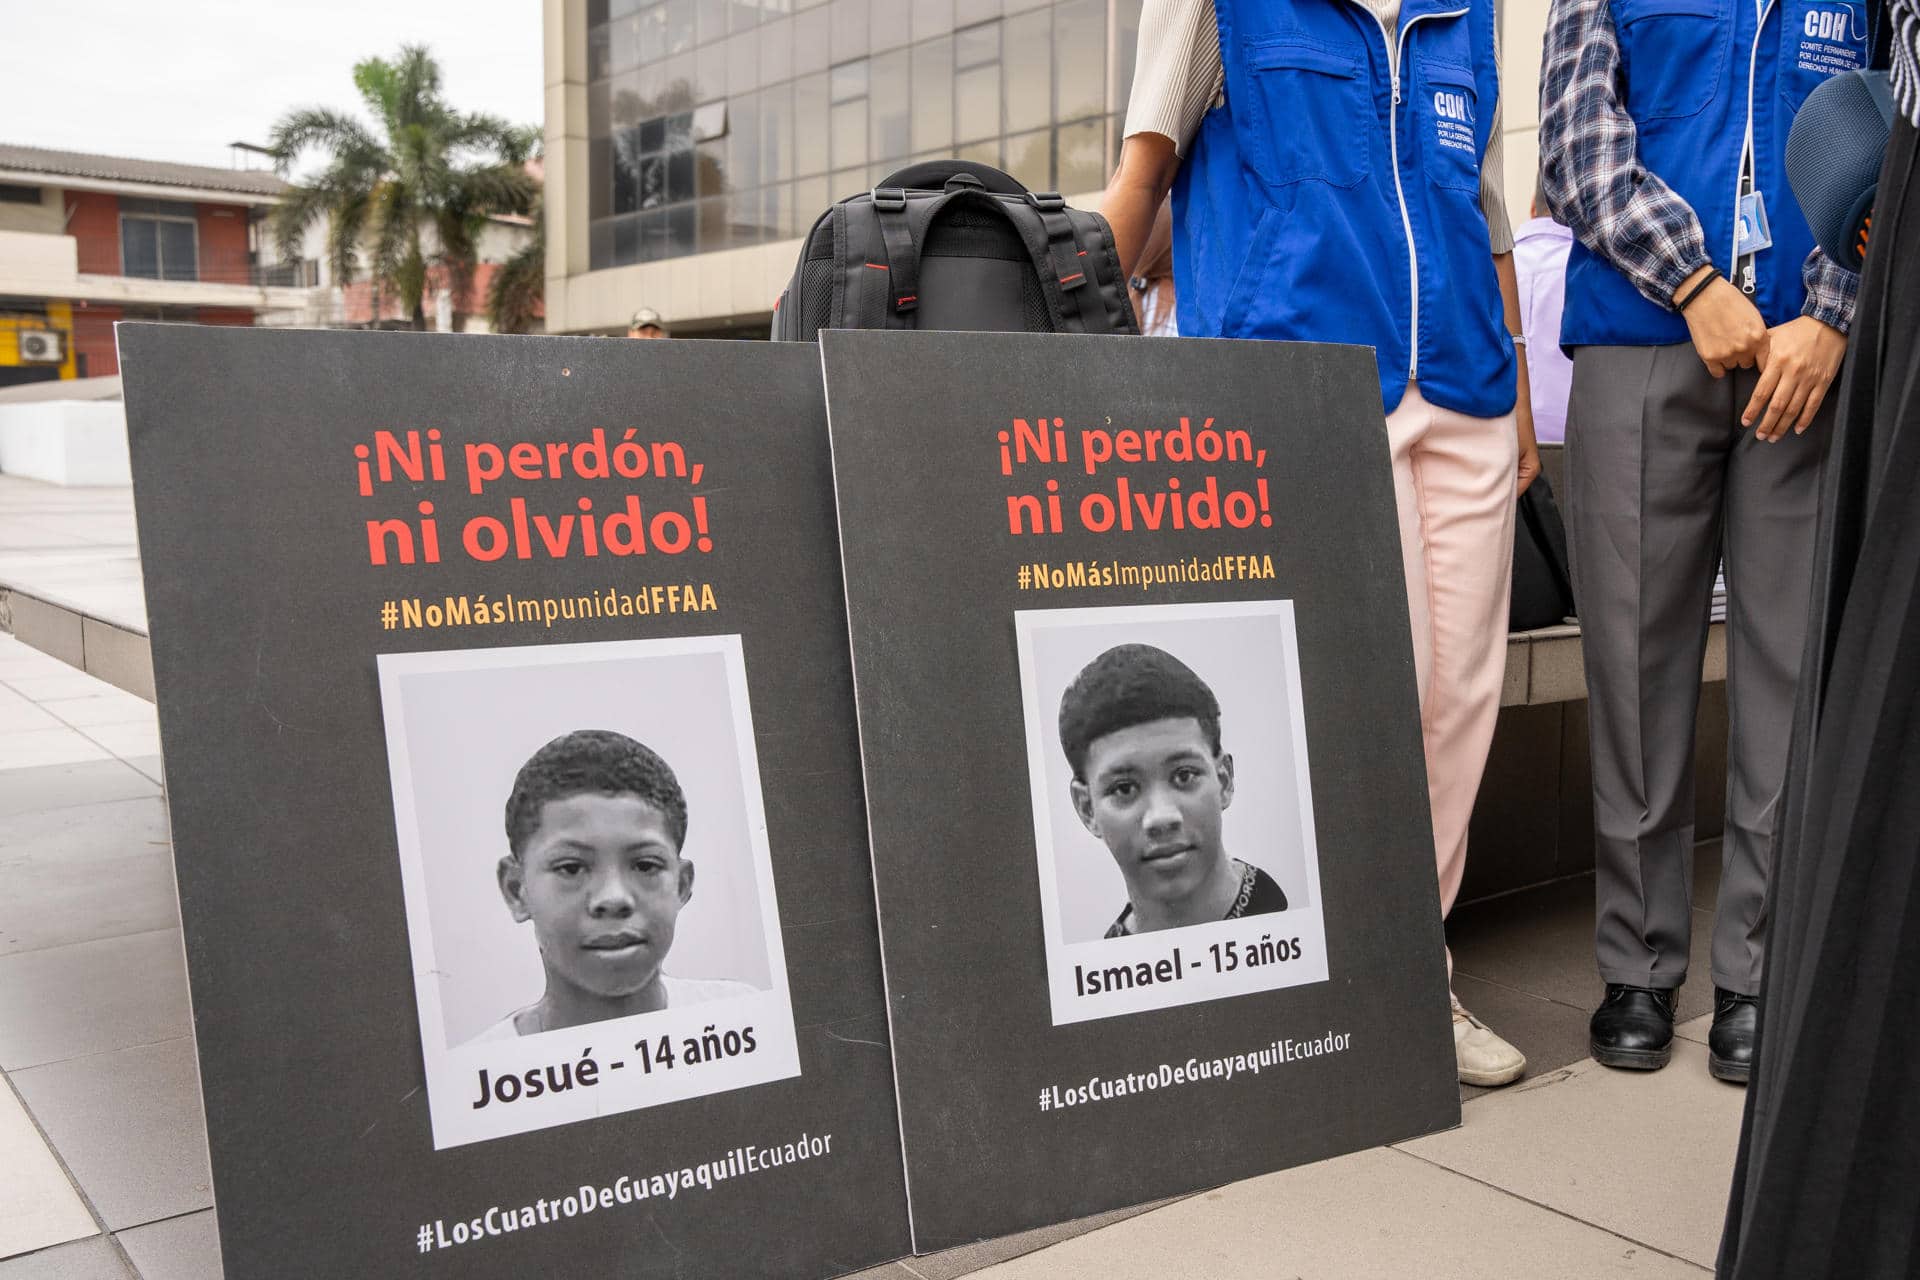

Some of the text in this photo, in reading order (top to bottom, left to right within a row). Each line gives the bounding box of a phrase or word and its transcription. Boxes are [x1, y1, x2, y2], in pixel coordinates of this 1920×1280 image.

[1805, 10, 1848, 42] CDH
[1434, 91, 1466, 122] CDH
[353, 427, 705, 497] ¡Ni perdón,
[997, 416, 1267, 476] ¡Ni perdón,
[366, 494, 714, 566] ni olvido!
[1006, 476, 1273, 535] ni olvido!
[1017, 554, 1276, 591] #NoMásImpunidadFFAA
[381, 583, 718, 630] #NoMásImpunidadFFAA
[1074, 933, 1302, 997] Ismael - 15 años
[473, 1024, 757, 1110] Josué - 14 años
[1038, 1030, 1351, 1112] #LosCuatroDeGuayaquilEcuador
[416, 1132, 832, 1254] #LosCuatroDeGuayaquilEcuador
